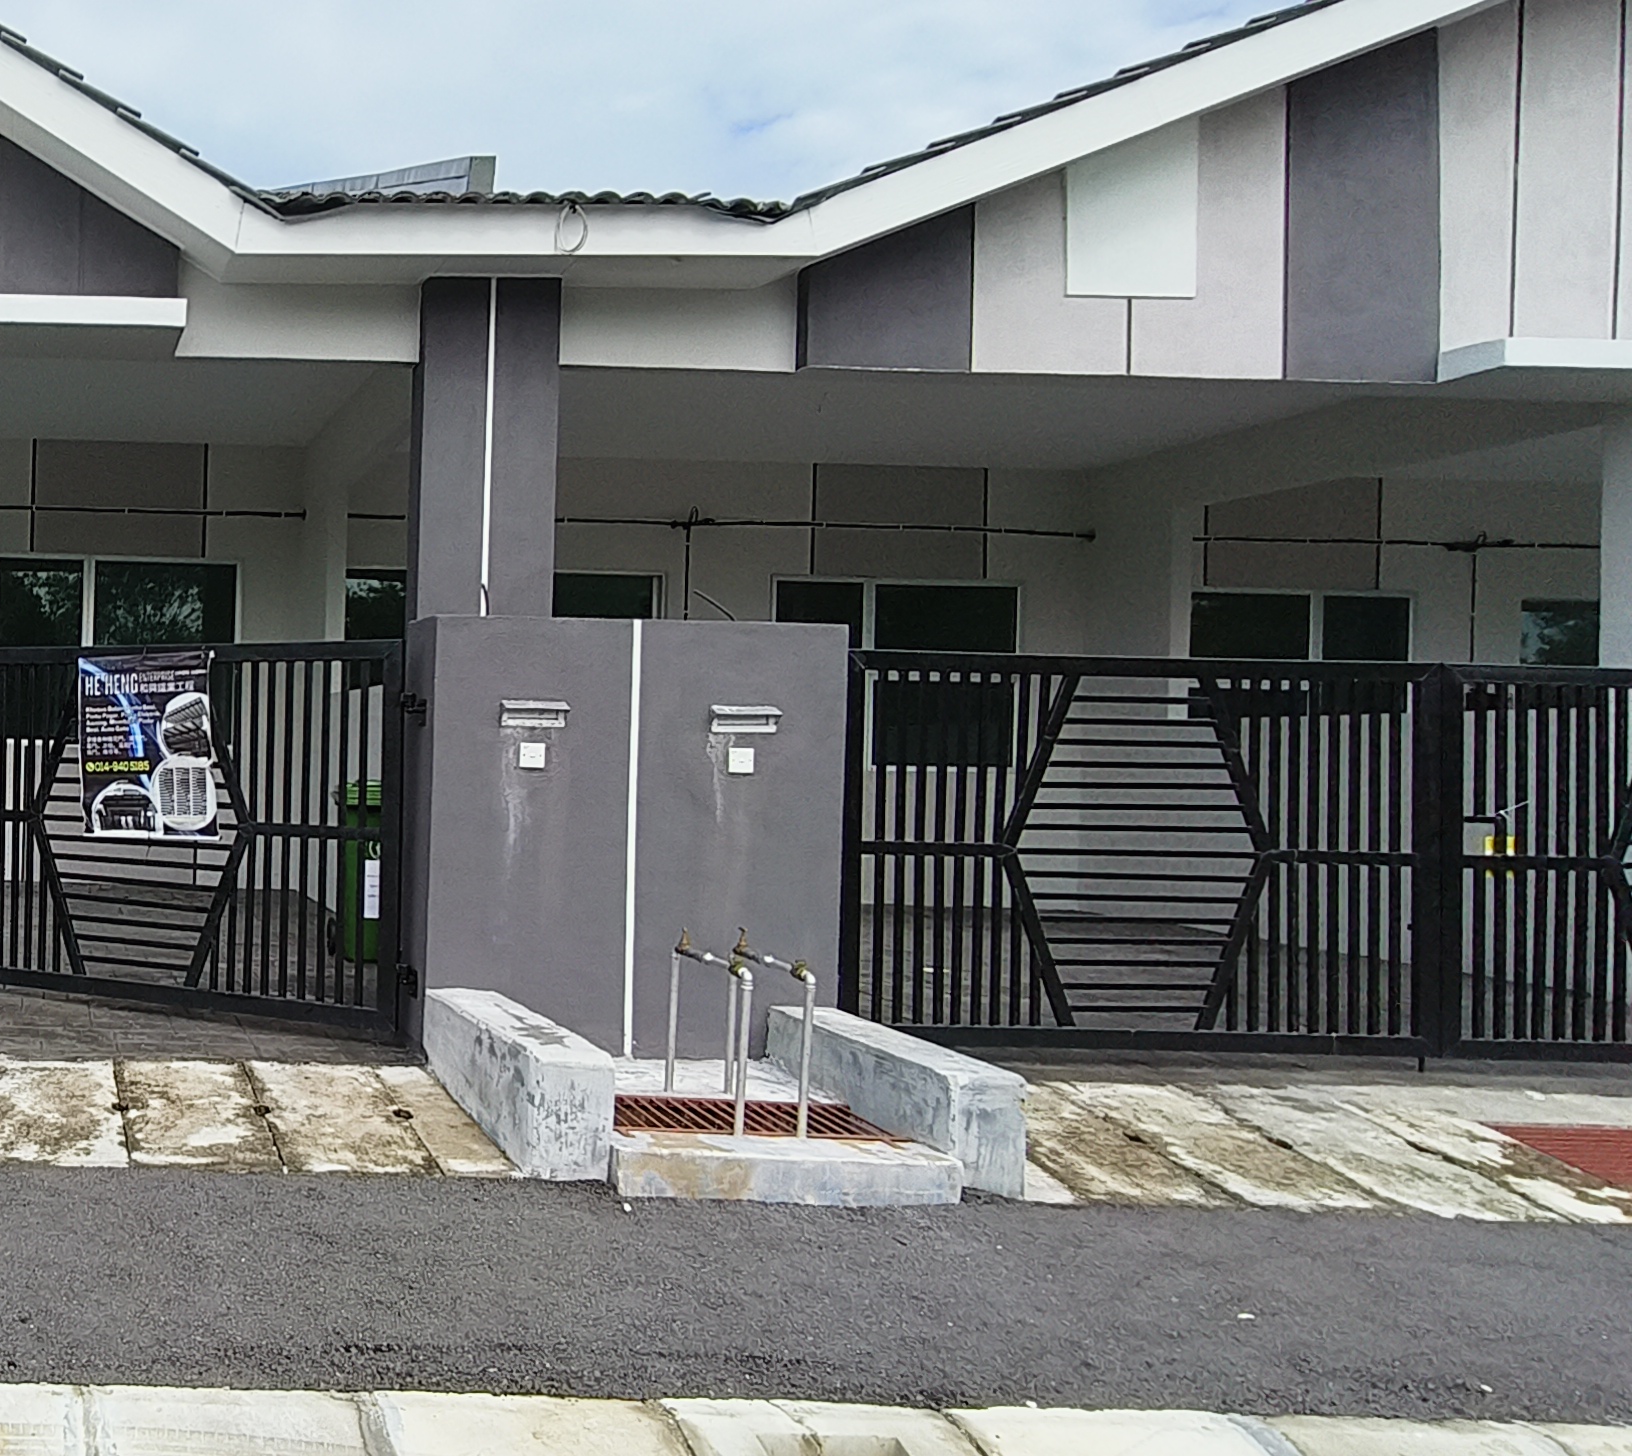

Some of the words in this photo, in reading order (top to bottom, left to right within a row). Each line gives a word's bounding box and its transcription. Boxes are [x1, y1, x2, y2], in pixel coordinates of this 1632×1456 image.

[85, 675, 101, 696] HE
[105, 673, 138, 696] HENG
[139, 670, 175, 682] ENTERPRISE
